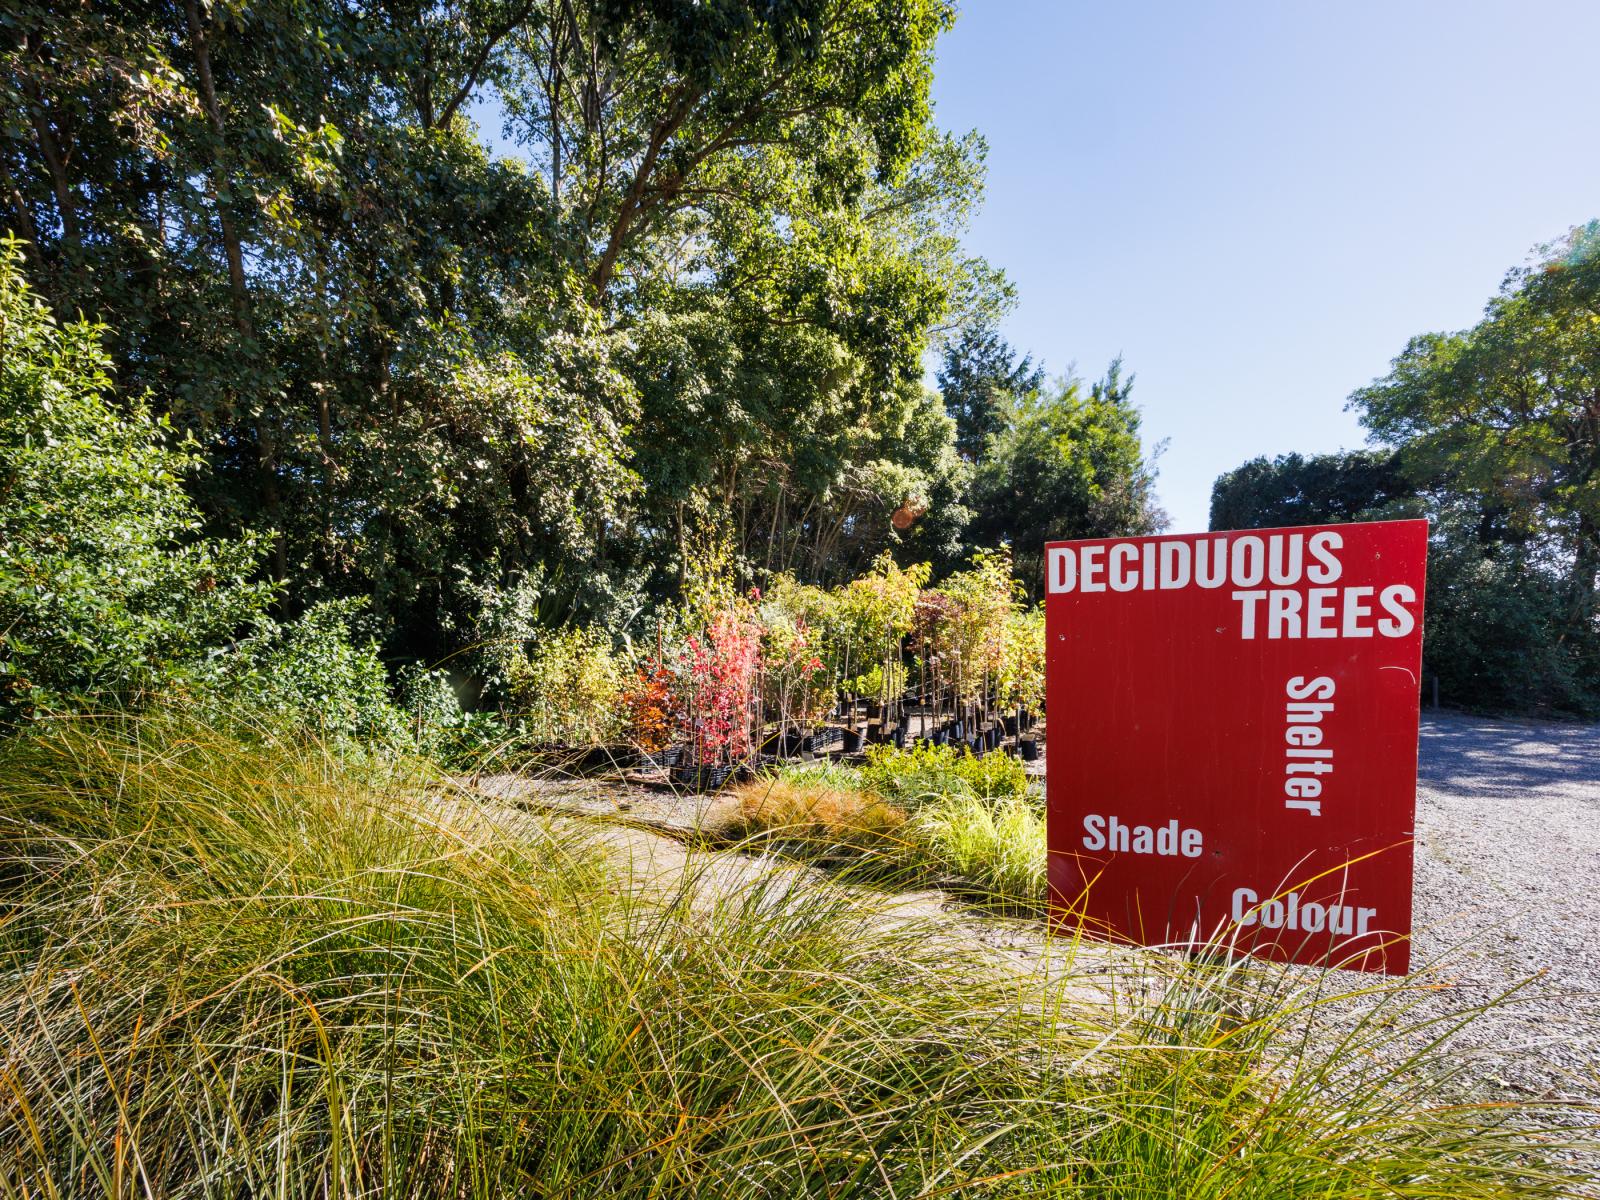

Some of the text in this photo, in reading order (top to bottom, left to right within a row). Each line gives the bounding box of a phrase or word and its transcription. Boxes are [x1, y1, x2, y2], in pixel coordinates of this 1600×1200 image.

[1048, 532, 1343, 594] DECIDUOUS
[1232, 585, 1416, 640] TREES
[1284, 676, 1336, 817] Shelter
[1082, 814, 1203, 858] Shade
[1231, 887, 1377, 936] Colour
